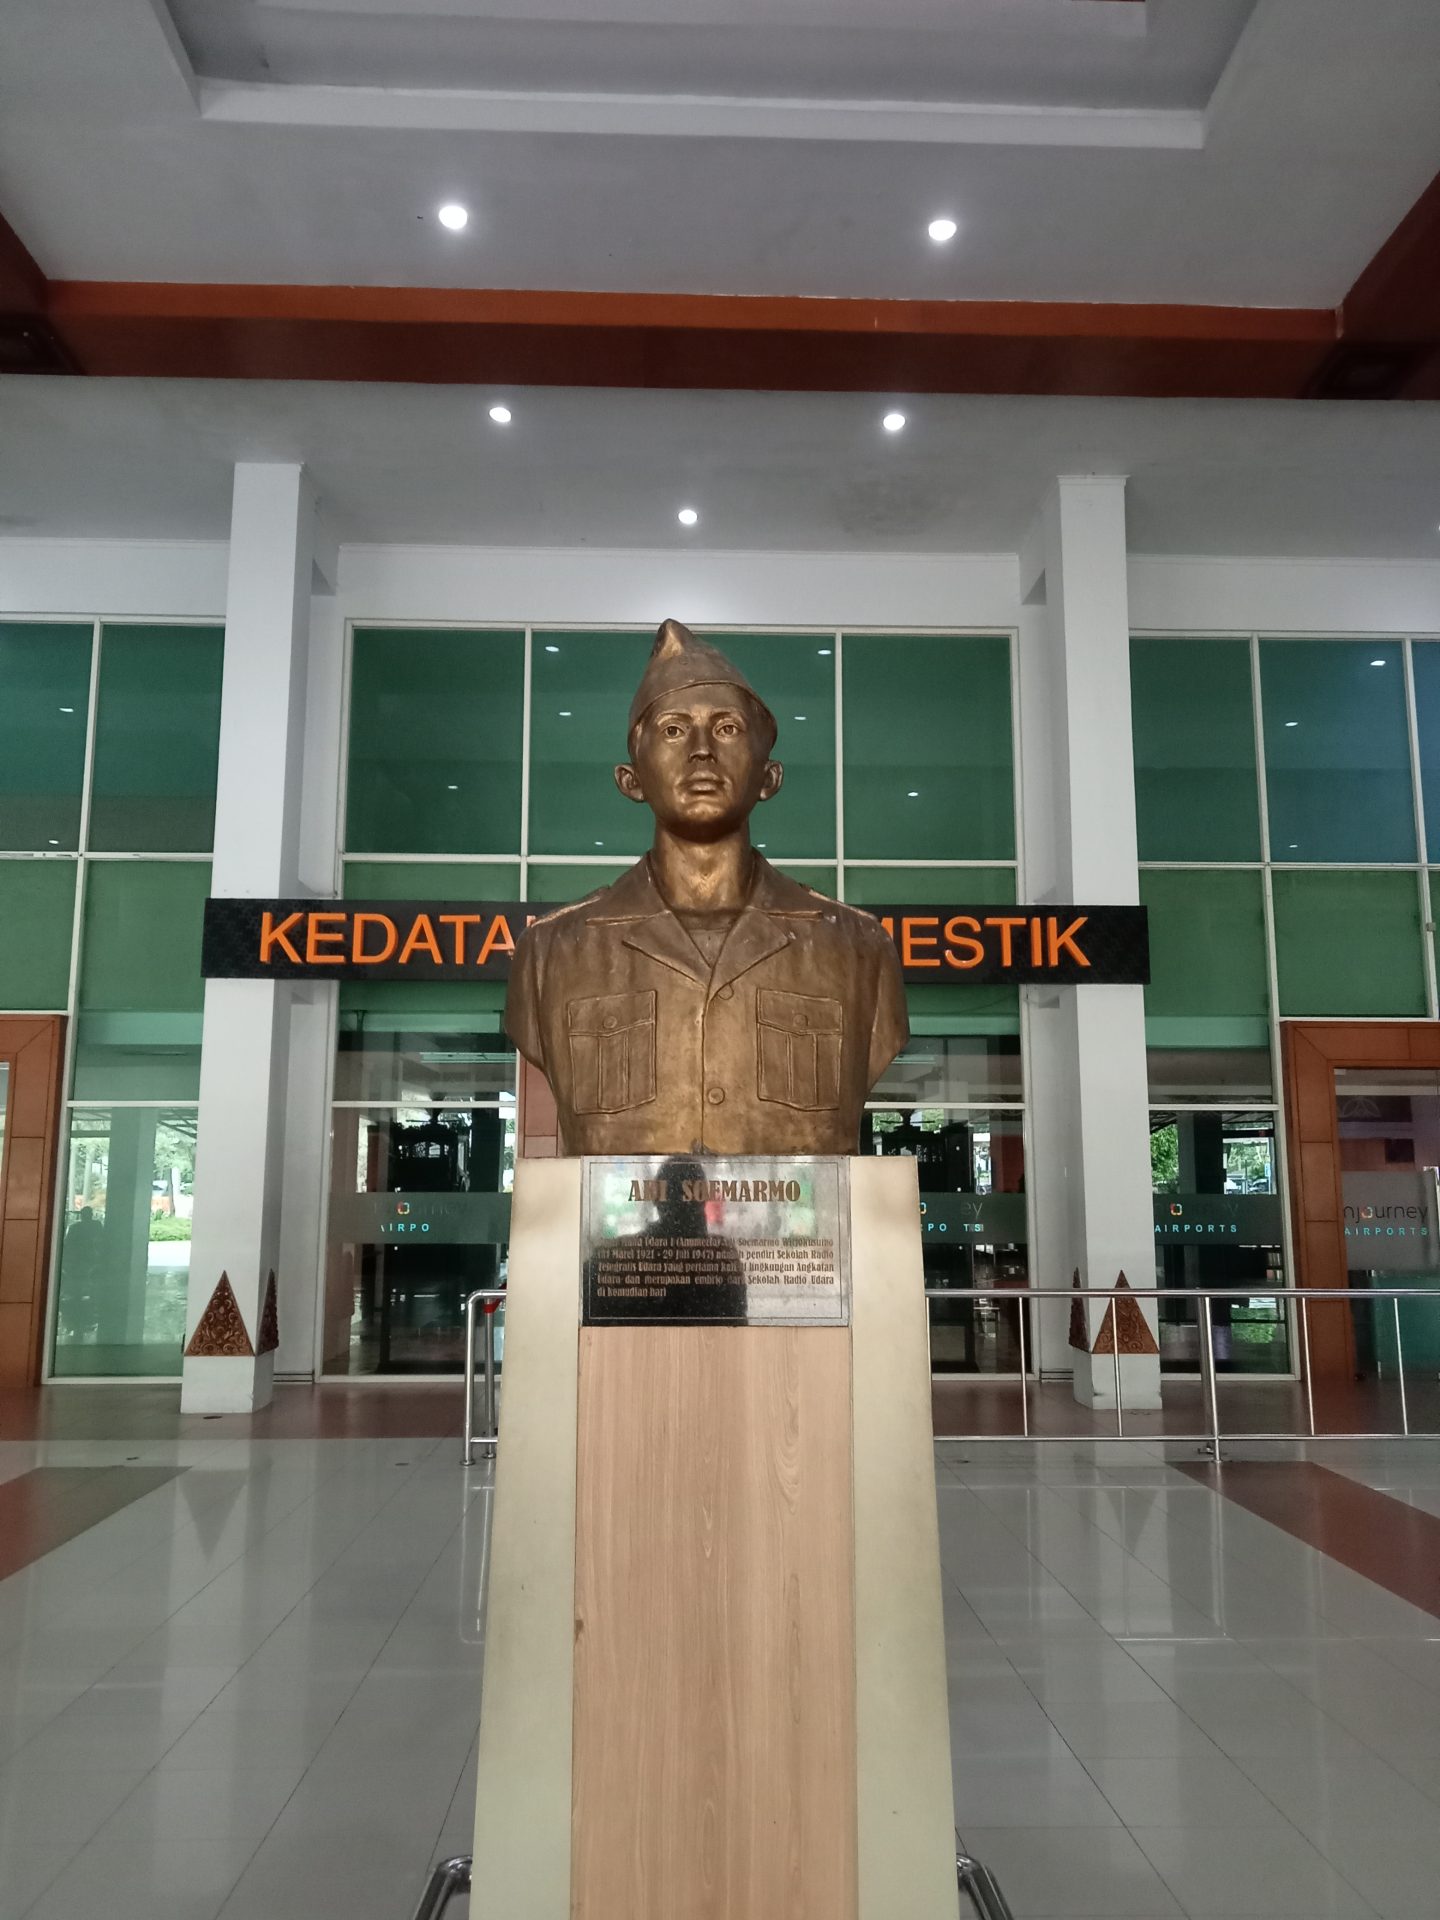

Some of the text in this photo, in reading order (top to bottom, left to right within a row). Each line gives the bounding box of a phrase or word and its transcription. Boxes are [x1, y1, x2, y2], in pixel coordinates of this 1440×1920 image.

[259, 911, 536, 964] KEDATA
[628, 1179, 801, 1202] ADI SOEMARMO
[1155, 1224, 1238, 1233] AIRPORTS
[1344, 1227, 1428, 1236] AIRPORTS
[662, 1249, 673, 1259] 29
[746, 1249, 775, 1260] pendiri
[777, 1249, 808, 1259] Sekolah
[811, 1249, 834, 1259] Radio
[685, 1262, 719, 1273] pertama
[797, 1262, 834, 1274] Angkatan
[625, 1274, 640, 1285] dan
[644, 1275, 690, 1286] merupakan
[748, 1275, 779, 1285] Sekolah
[784, 1275, 807, 1285] Radio
[812, 1275, 834, 1285] Udara
[608, 1287, 647, 1297] kemudian
[649, 1287, 666, 1297] hari
